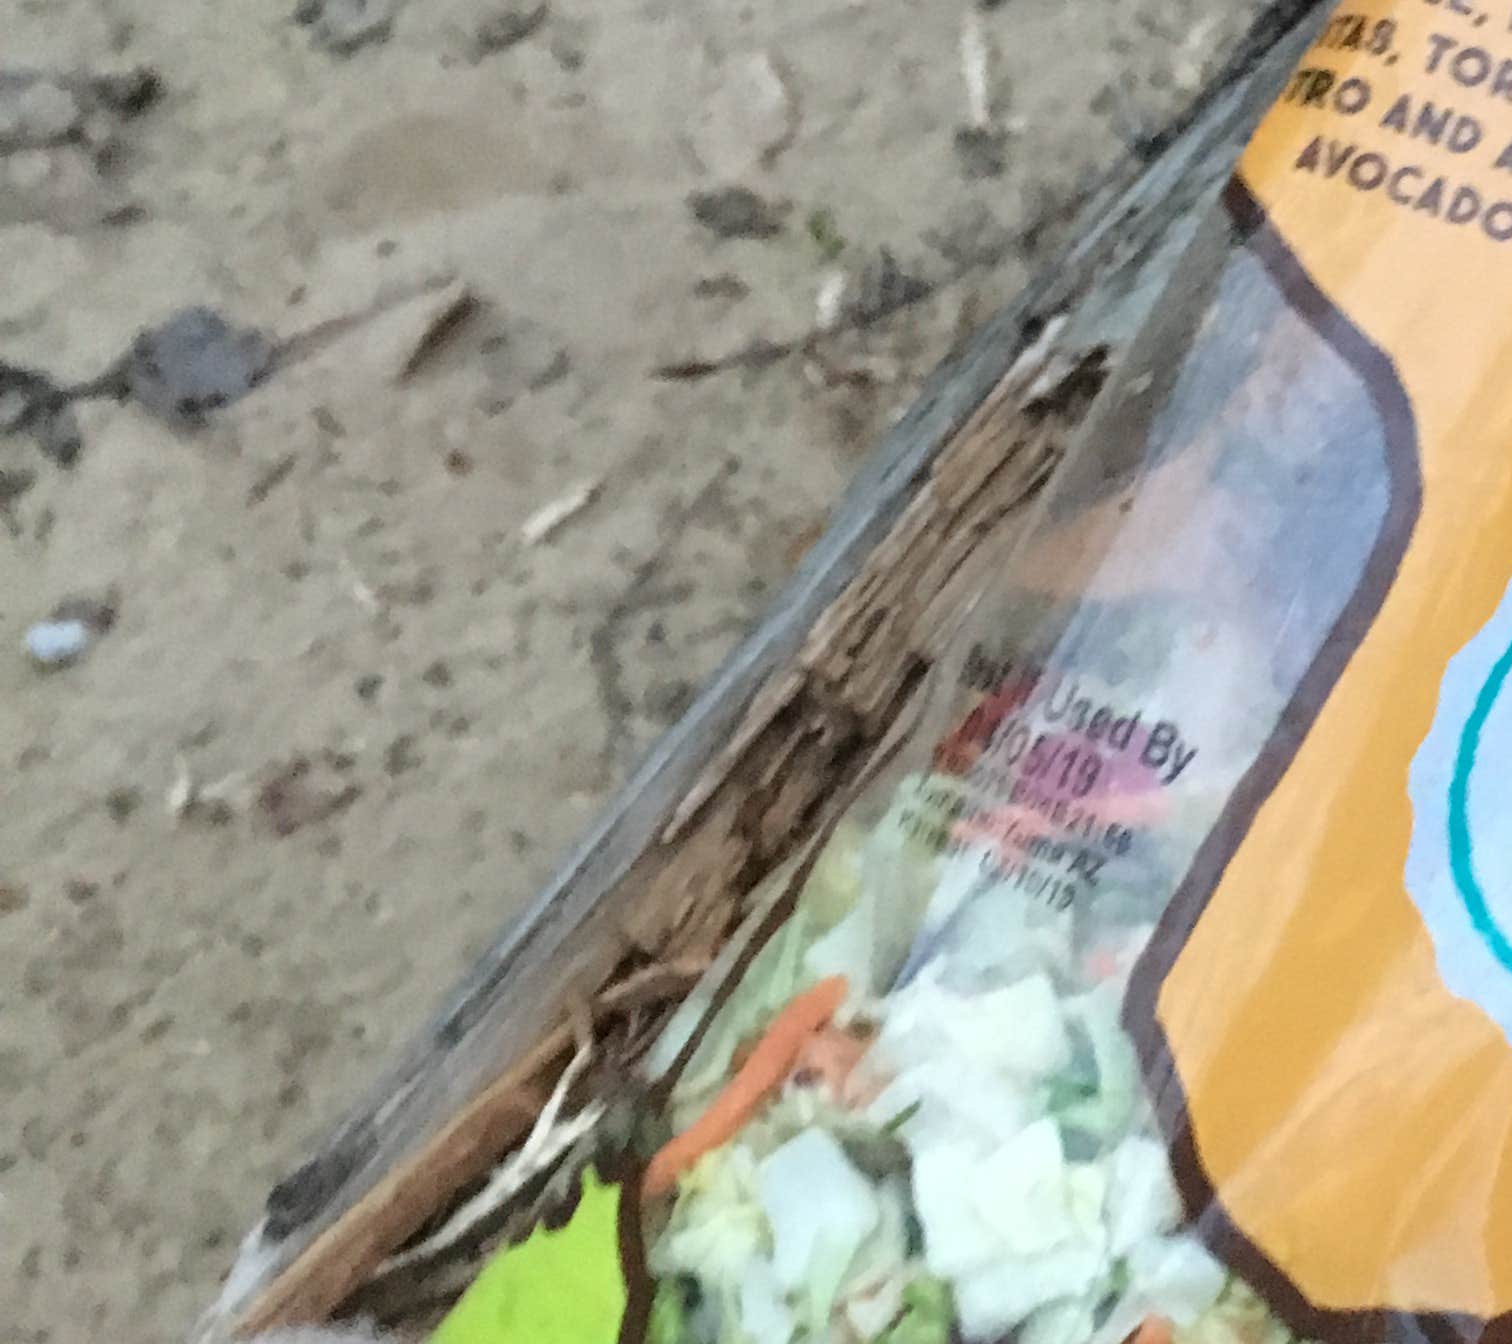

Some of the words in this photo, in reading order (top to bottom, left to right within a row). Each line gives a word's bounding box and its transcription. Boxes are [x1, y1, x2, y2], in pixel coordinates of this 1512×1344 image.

[1380, 92, 1483, 154] AND
[1043, 682, 1141, 751] Used
[1139, 719, 1200, 787] By
